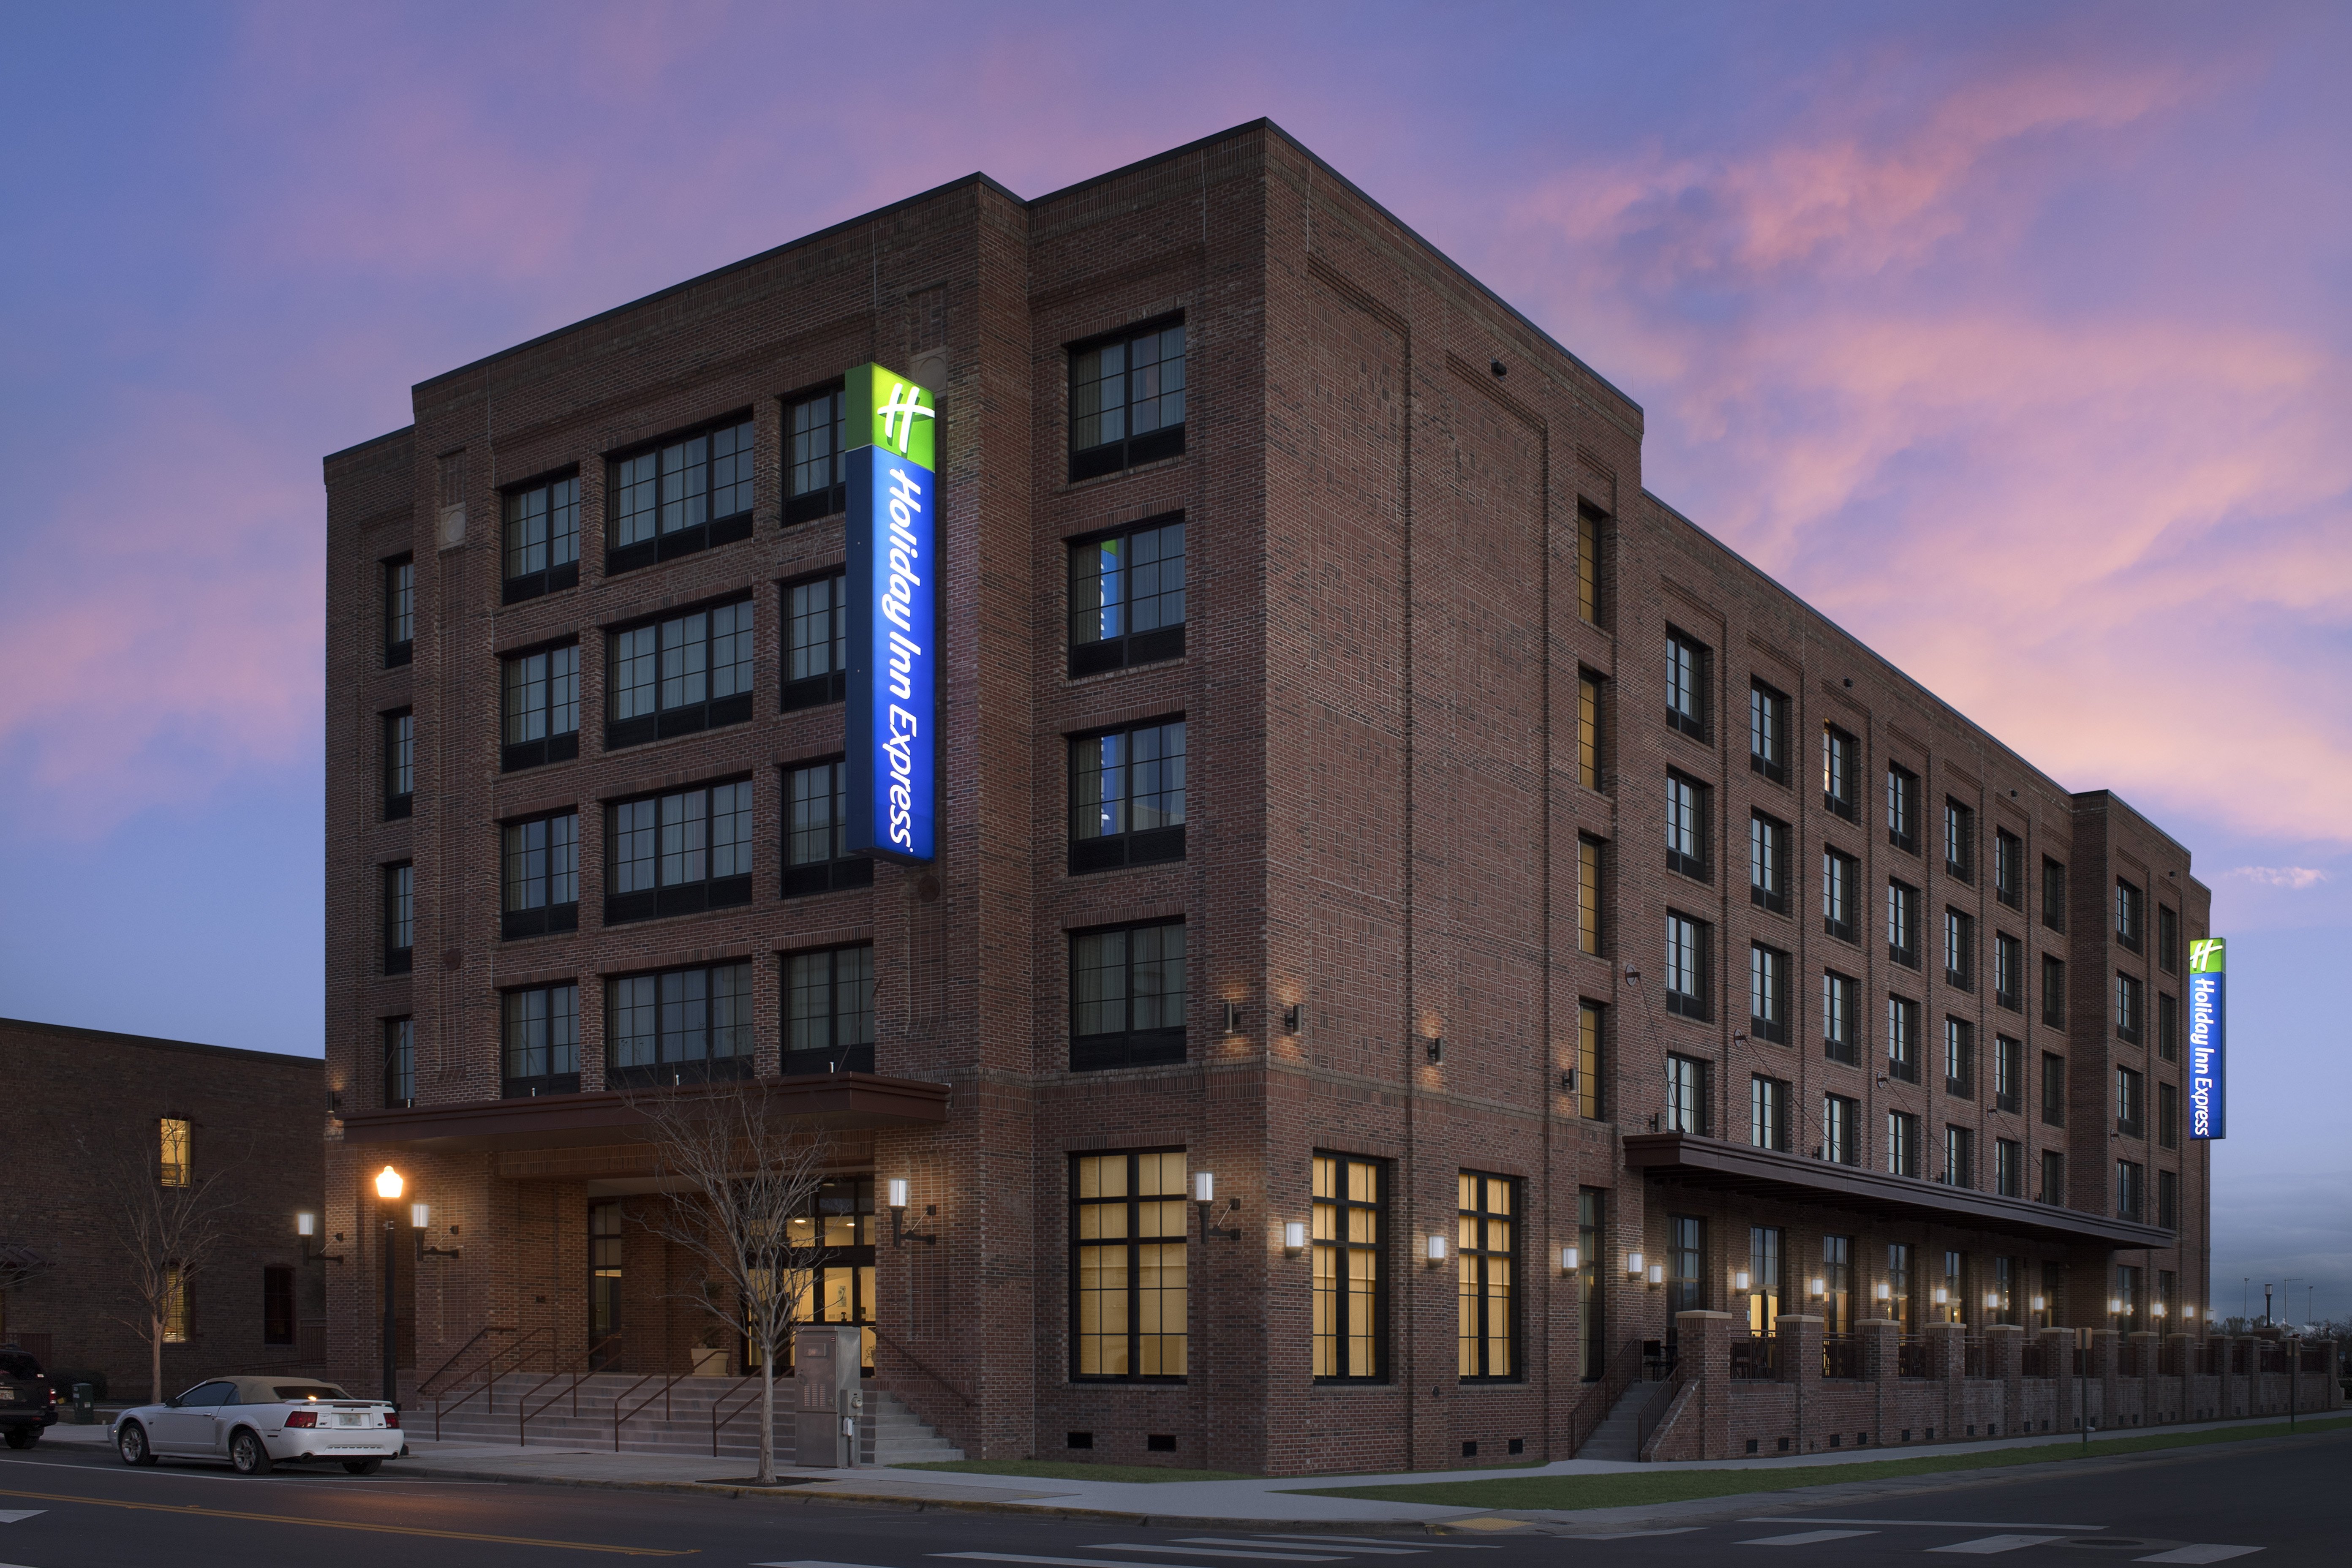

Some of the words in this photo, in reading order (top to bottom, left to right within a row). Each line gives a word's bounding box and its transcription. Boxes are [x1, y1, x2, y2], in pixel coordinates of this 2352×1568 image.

[882, 468, 921, 632] Holiday
[889, 631, 921, 700] Inn
[882, 704, 917, 848] Express
[2190, 978, 2215, 1045] Holiday
[2194, 1047, 2215, 1074] Inn
[2191, 1077, 2212, 1135] Express
